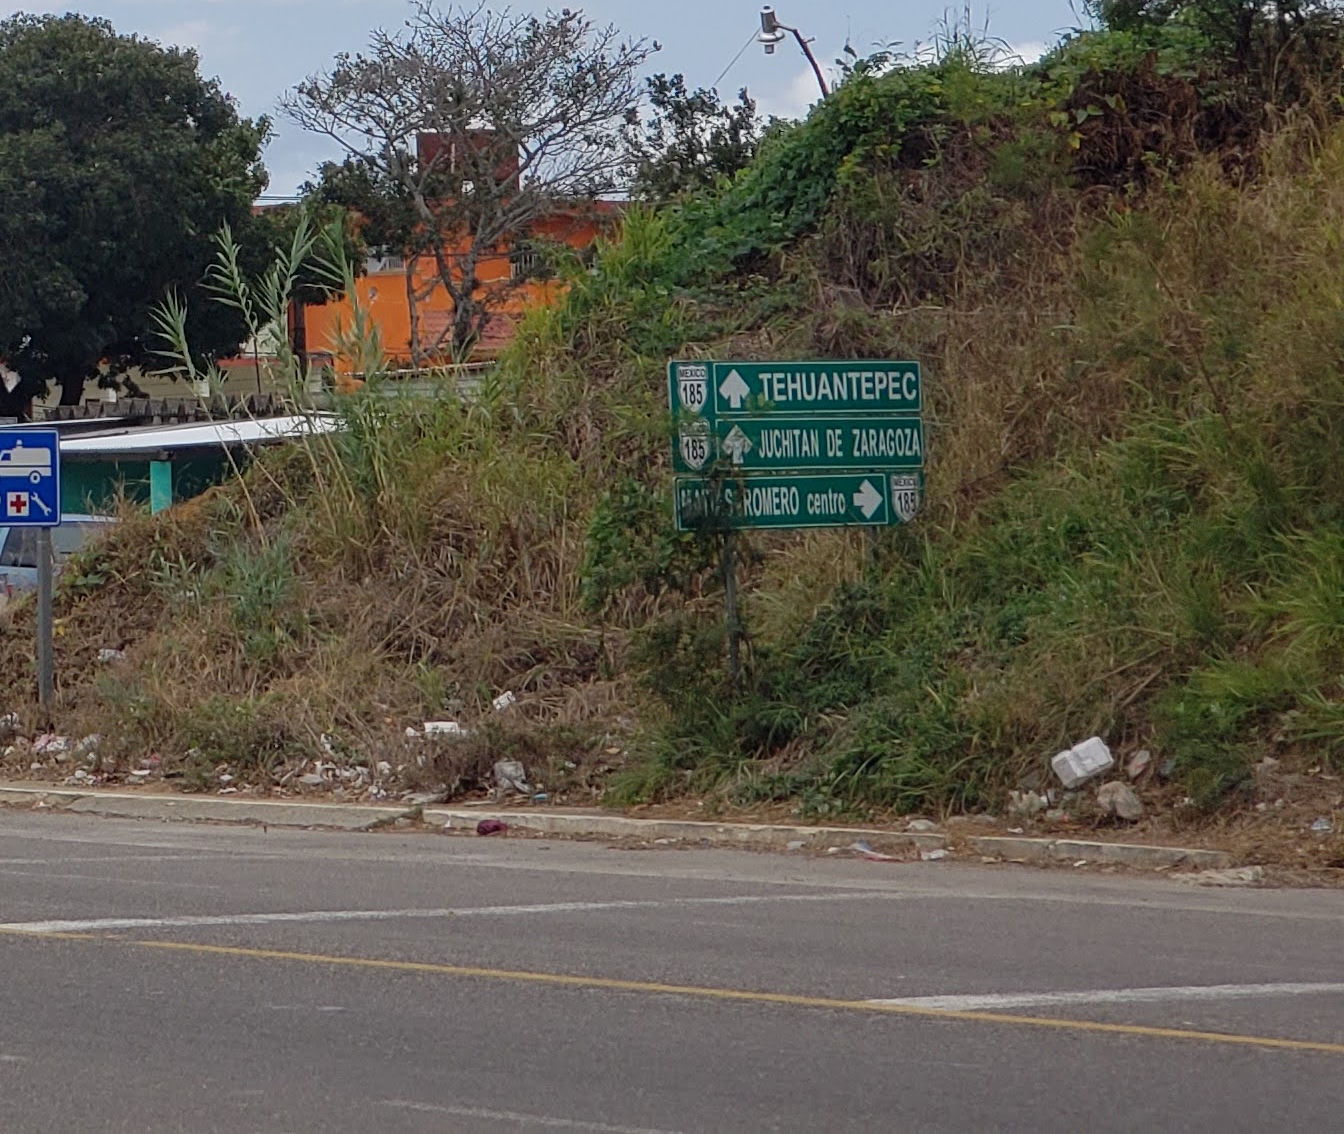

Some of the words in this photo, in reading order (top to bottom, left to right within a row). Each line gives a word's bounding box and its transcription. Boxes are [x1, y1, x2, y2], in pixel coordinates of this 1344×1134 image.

[679, 369, 706, 378] MEXICO
[759, 371, 917, 402] TEHUANTEPEC
[683, 383, 703, 405] 185
[684, 439, 705, 460] 185
[758, 429, 820, 458] JUCHITAN
[827, 429, 844, 457] DE
[853, 428, 921, 457] ZARAGOZA
[742, 486, 800, 517] ROMERO
[807, 489, 846, 515] centro
